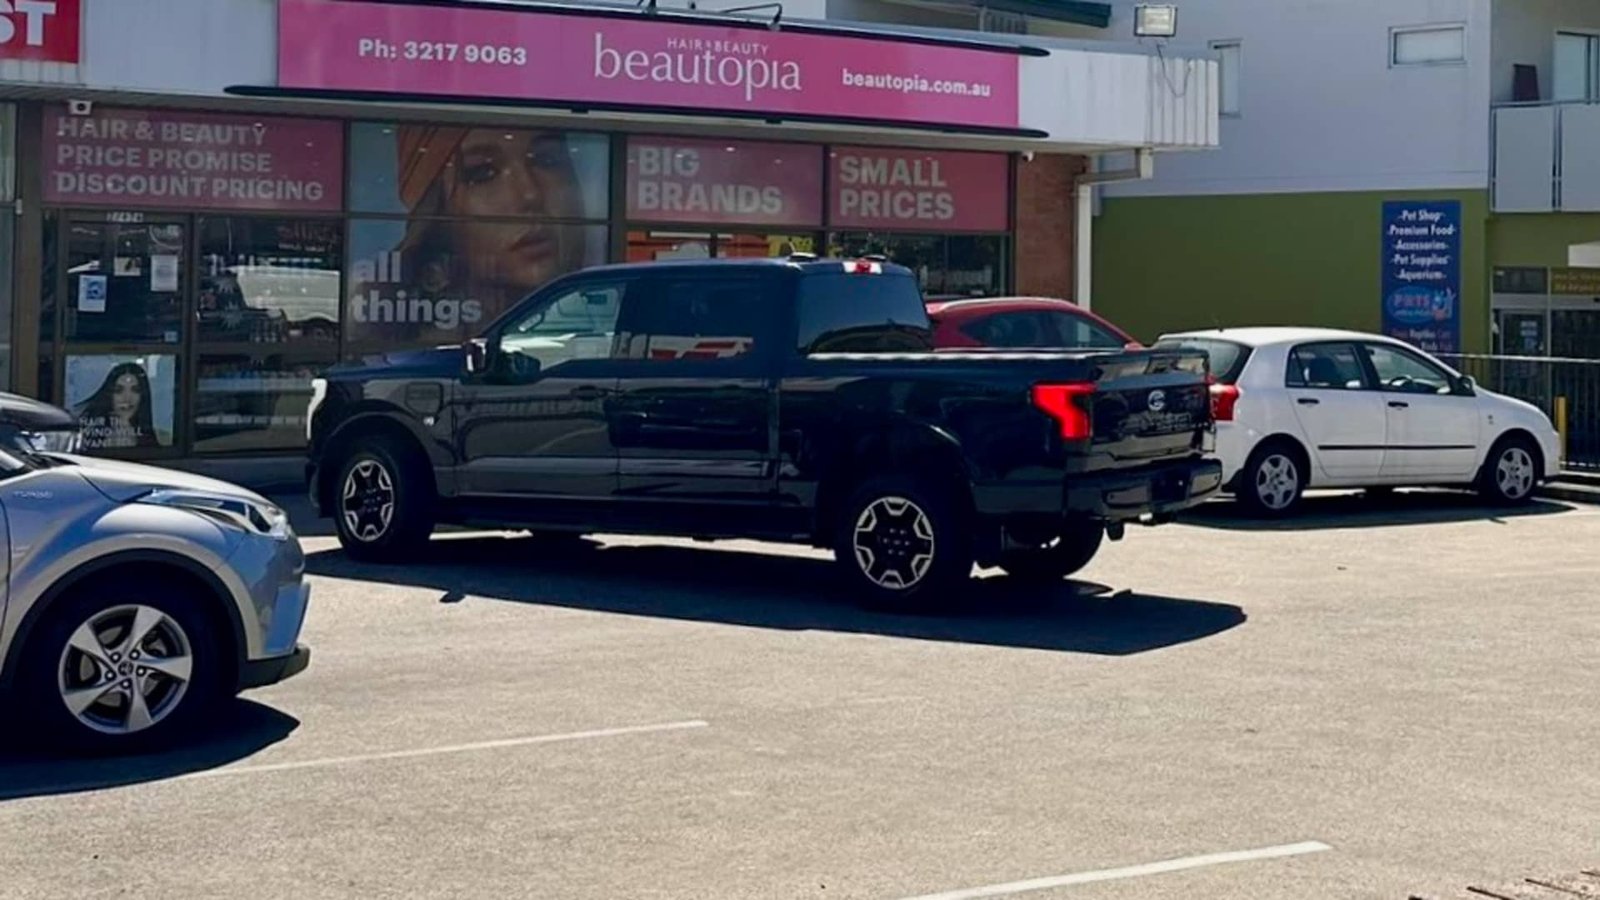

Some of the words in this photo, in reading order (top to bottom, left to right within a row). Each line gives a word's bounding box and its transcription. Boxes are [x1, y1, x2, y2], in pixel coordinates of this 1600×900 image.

[358, 38, 397, 58] Ph:
[403, 41, 458, 61] 3217
[464, 45, 527, 65] 9063
[667, 38, 702, 49] HAIR
[714, 41, 769, 55] BEAUTY
[594, 33, 802, 101] beautopia
[842, 68, 991, 97] beautopia.com.au
[57, 116, 128, 139] HAIR
[135, 121, 155, 140] &
[161, 121, 266, 146] BEAUTY
[57, 144, 142, 168] PRICE
[148, 148, 272, 173] PROMISE
[638, 147, 700, 176] BIG
[839, 155, 946, 187] SMALL
[57, 171, 206, 197] DISCOUNT
[212, 177, 324, 201] PRICING
[638, 181, 783, 214] BRANDS
[839, 190, 954, 220] PRICES
[352, 250, 401, 283] all
[351, 289, 481, 329] things
